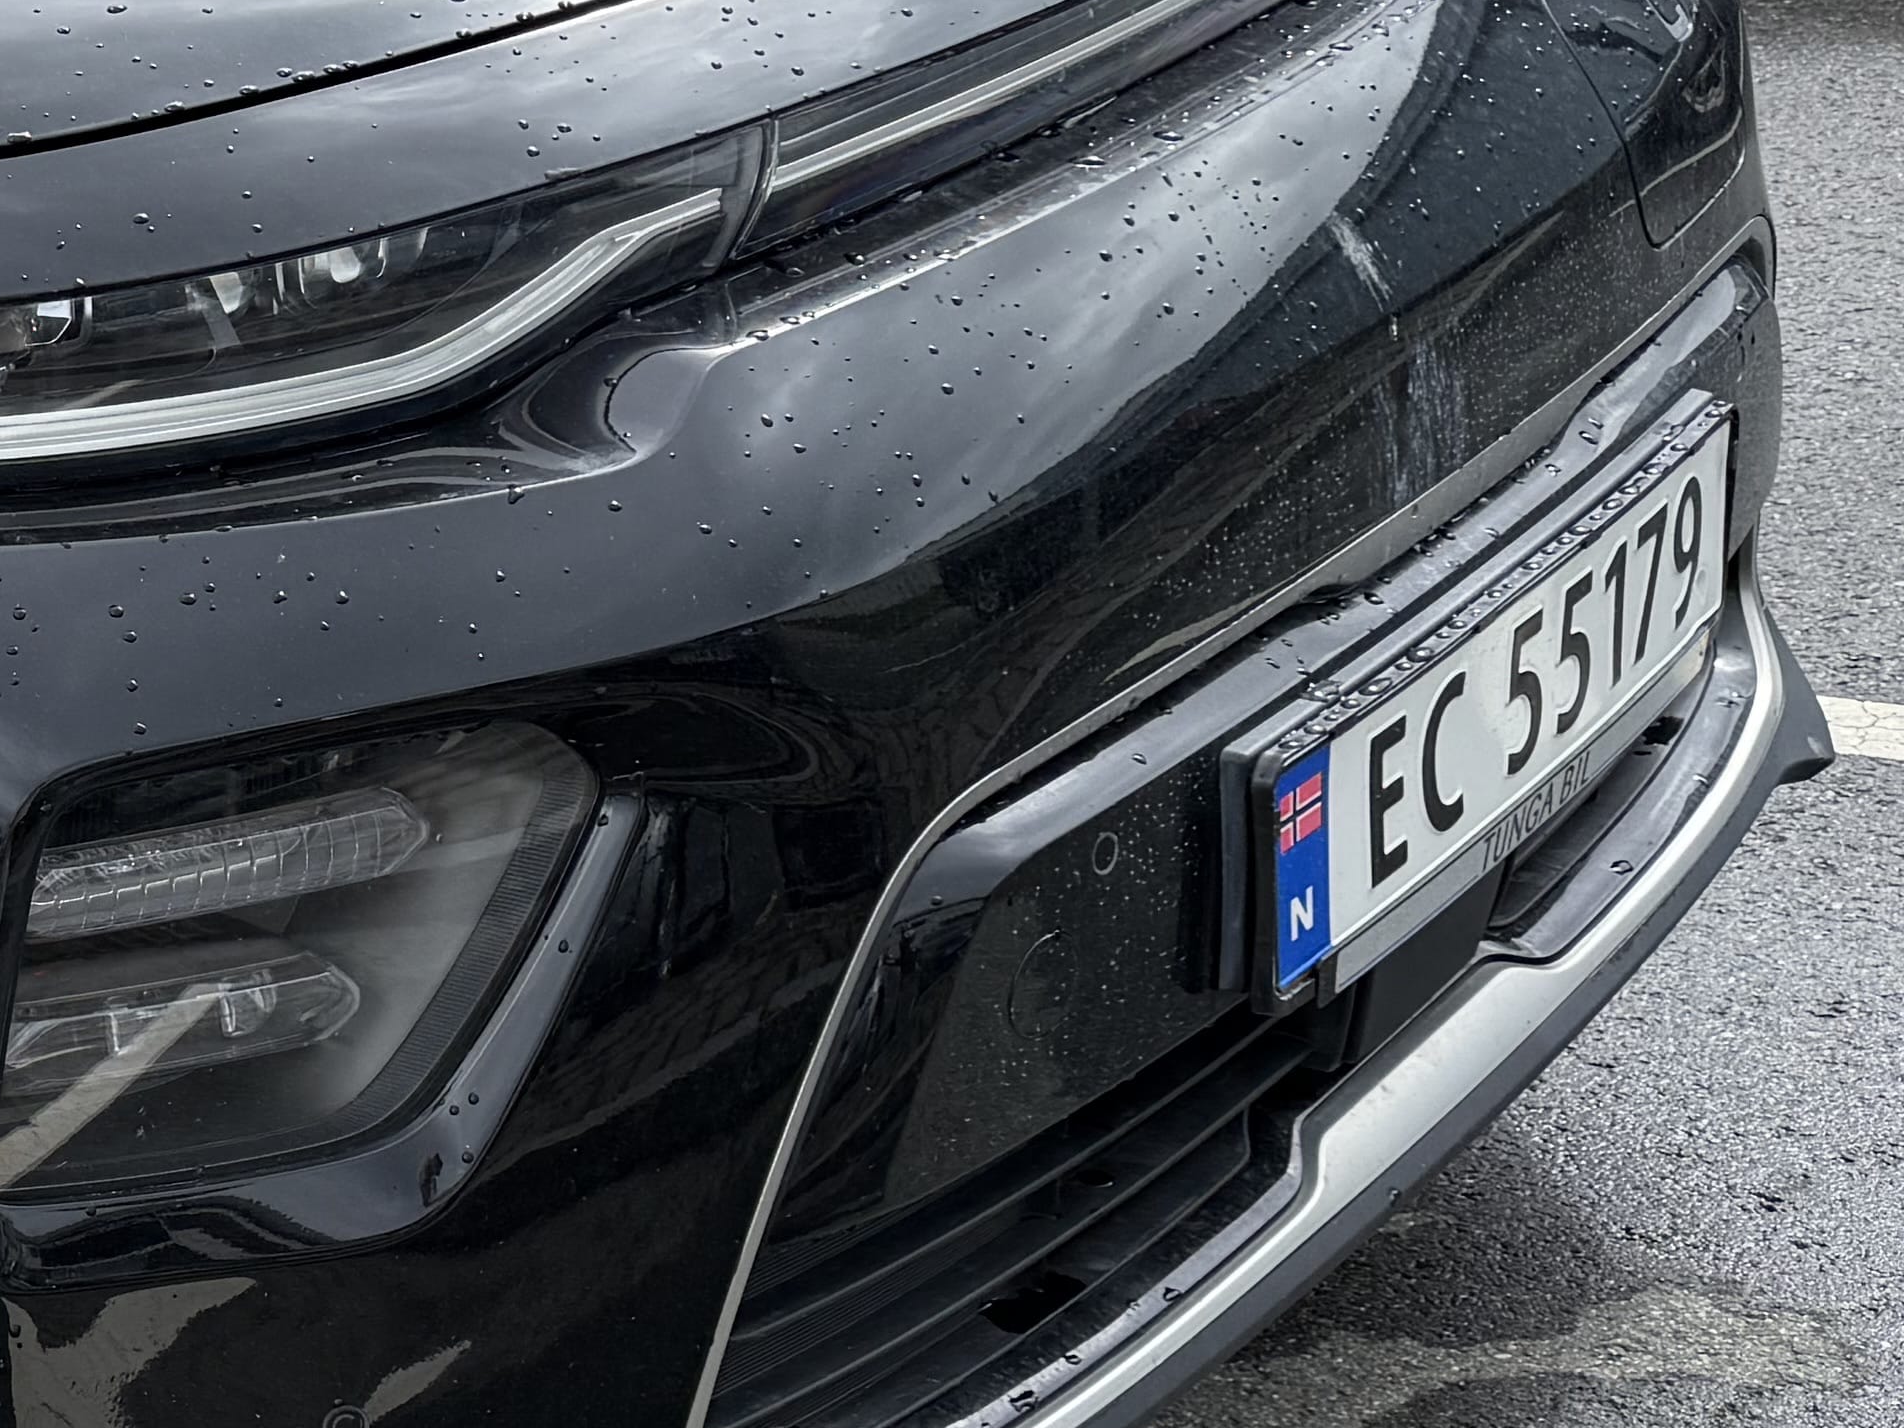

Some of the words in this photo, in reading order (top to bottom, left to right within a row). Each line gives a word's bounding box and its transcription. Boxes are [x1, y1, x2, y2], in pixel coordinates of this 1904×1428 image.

[1289, 885, 1315, 942] N
[1368, 671, 1465, 889] EC
[1506, 476, 1704, 776] 55179
[1482, 781, 1553, 873] TUNGA
[1559, 750, 1591, 805] BIL
